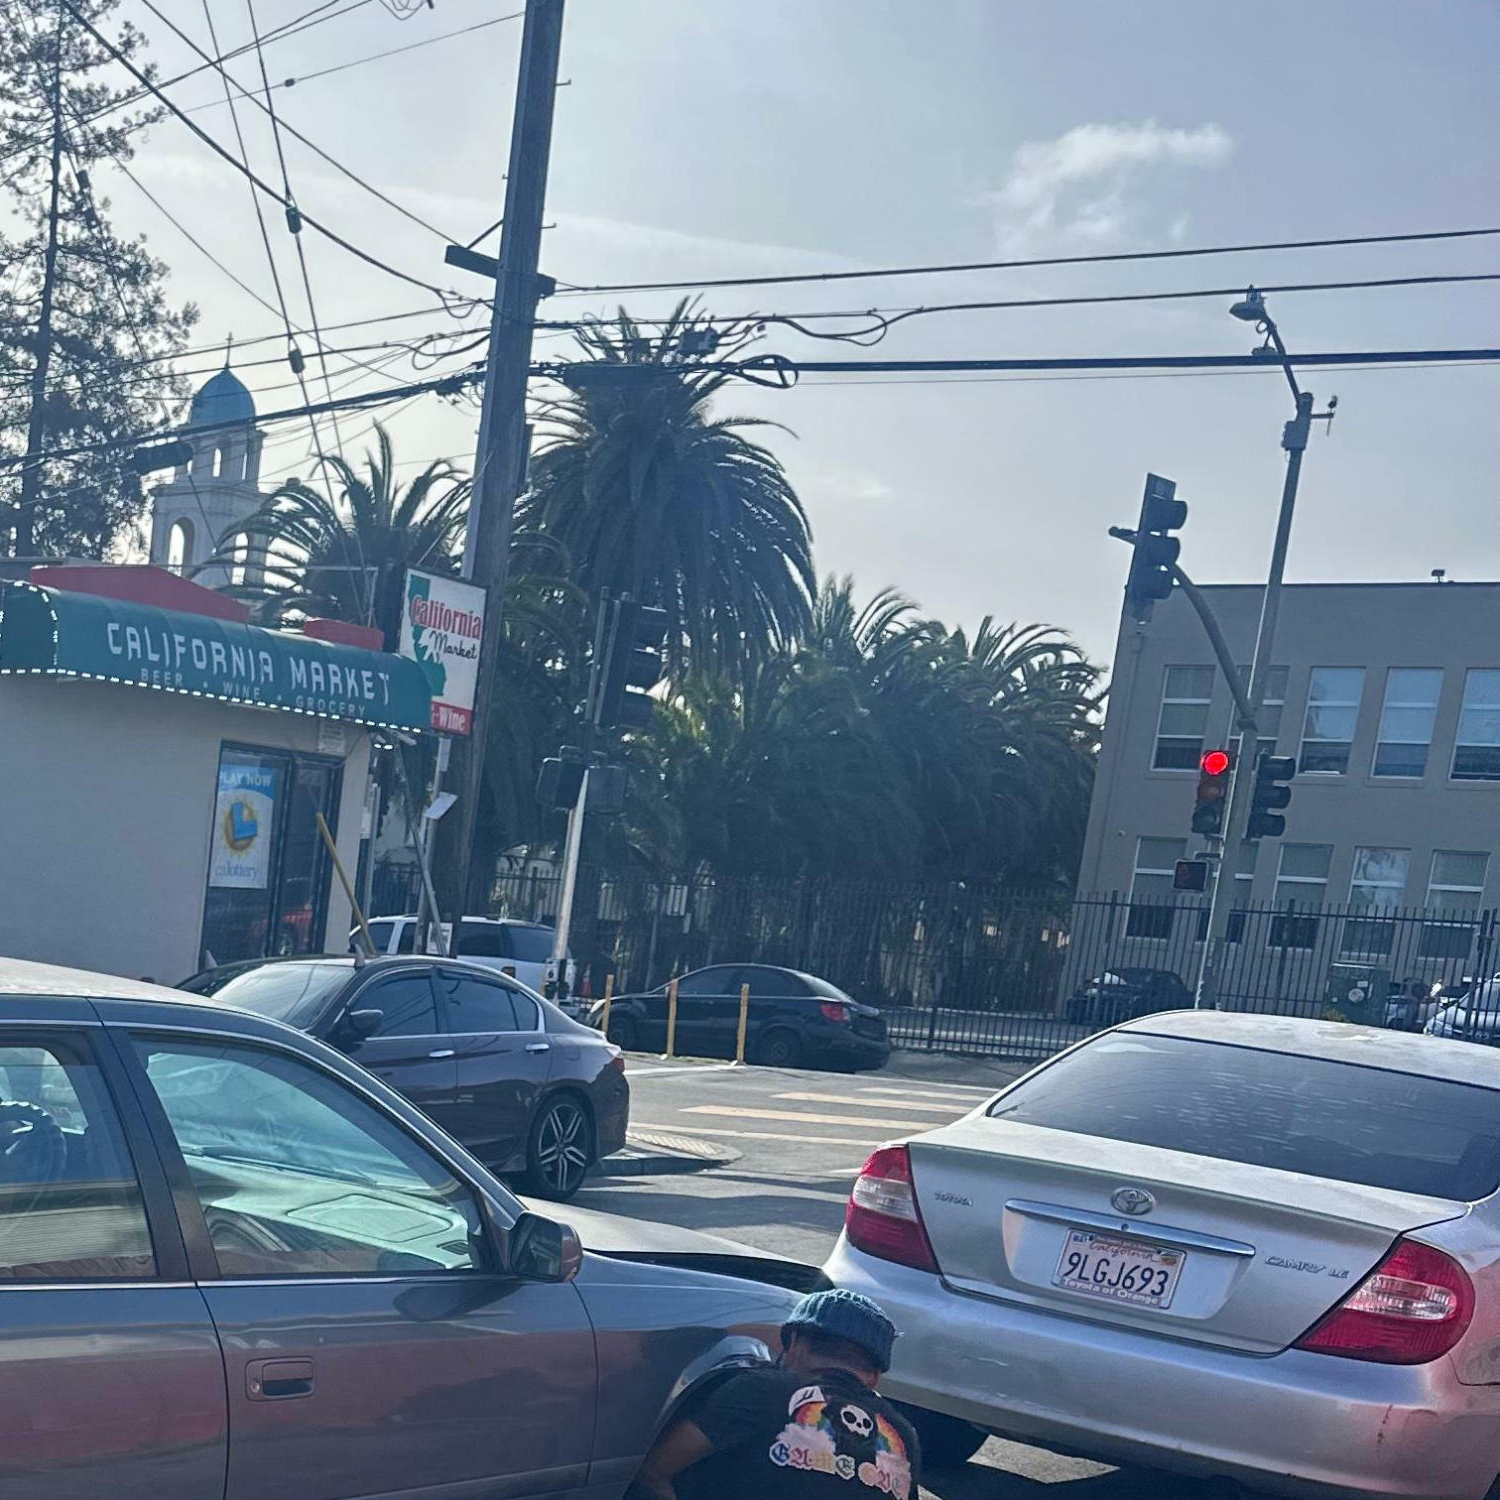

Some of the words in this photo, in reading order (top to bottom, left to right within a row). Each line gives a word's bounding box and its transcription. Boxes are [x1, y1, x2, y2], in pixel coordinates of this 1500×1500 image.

[411, 593, 482, 640] California
[107, 622, 274, 685] CALIFORNIA
[289, 656, 390, 706] MARKET
[428, 629, 478, 660] Market
[140, 667, 184, 687] BEER
[222, 681, 261, 698] WINE
[295, 693, 366, 717] GROCERY
[219, 770, 242, 785] PLAY
[246, 773, 273, 787] NOW
[1062, 1251, 1169, 1297] 9LGJ693
[1063, 1279, 1100, 1293] Toyota
[1102, 1286, 1114, 1295] of
[1116, 1289, 1159, 1305] Orange
